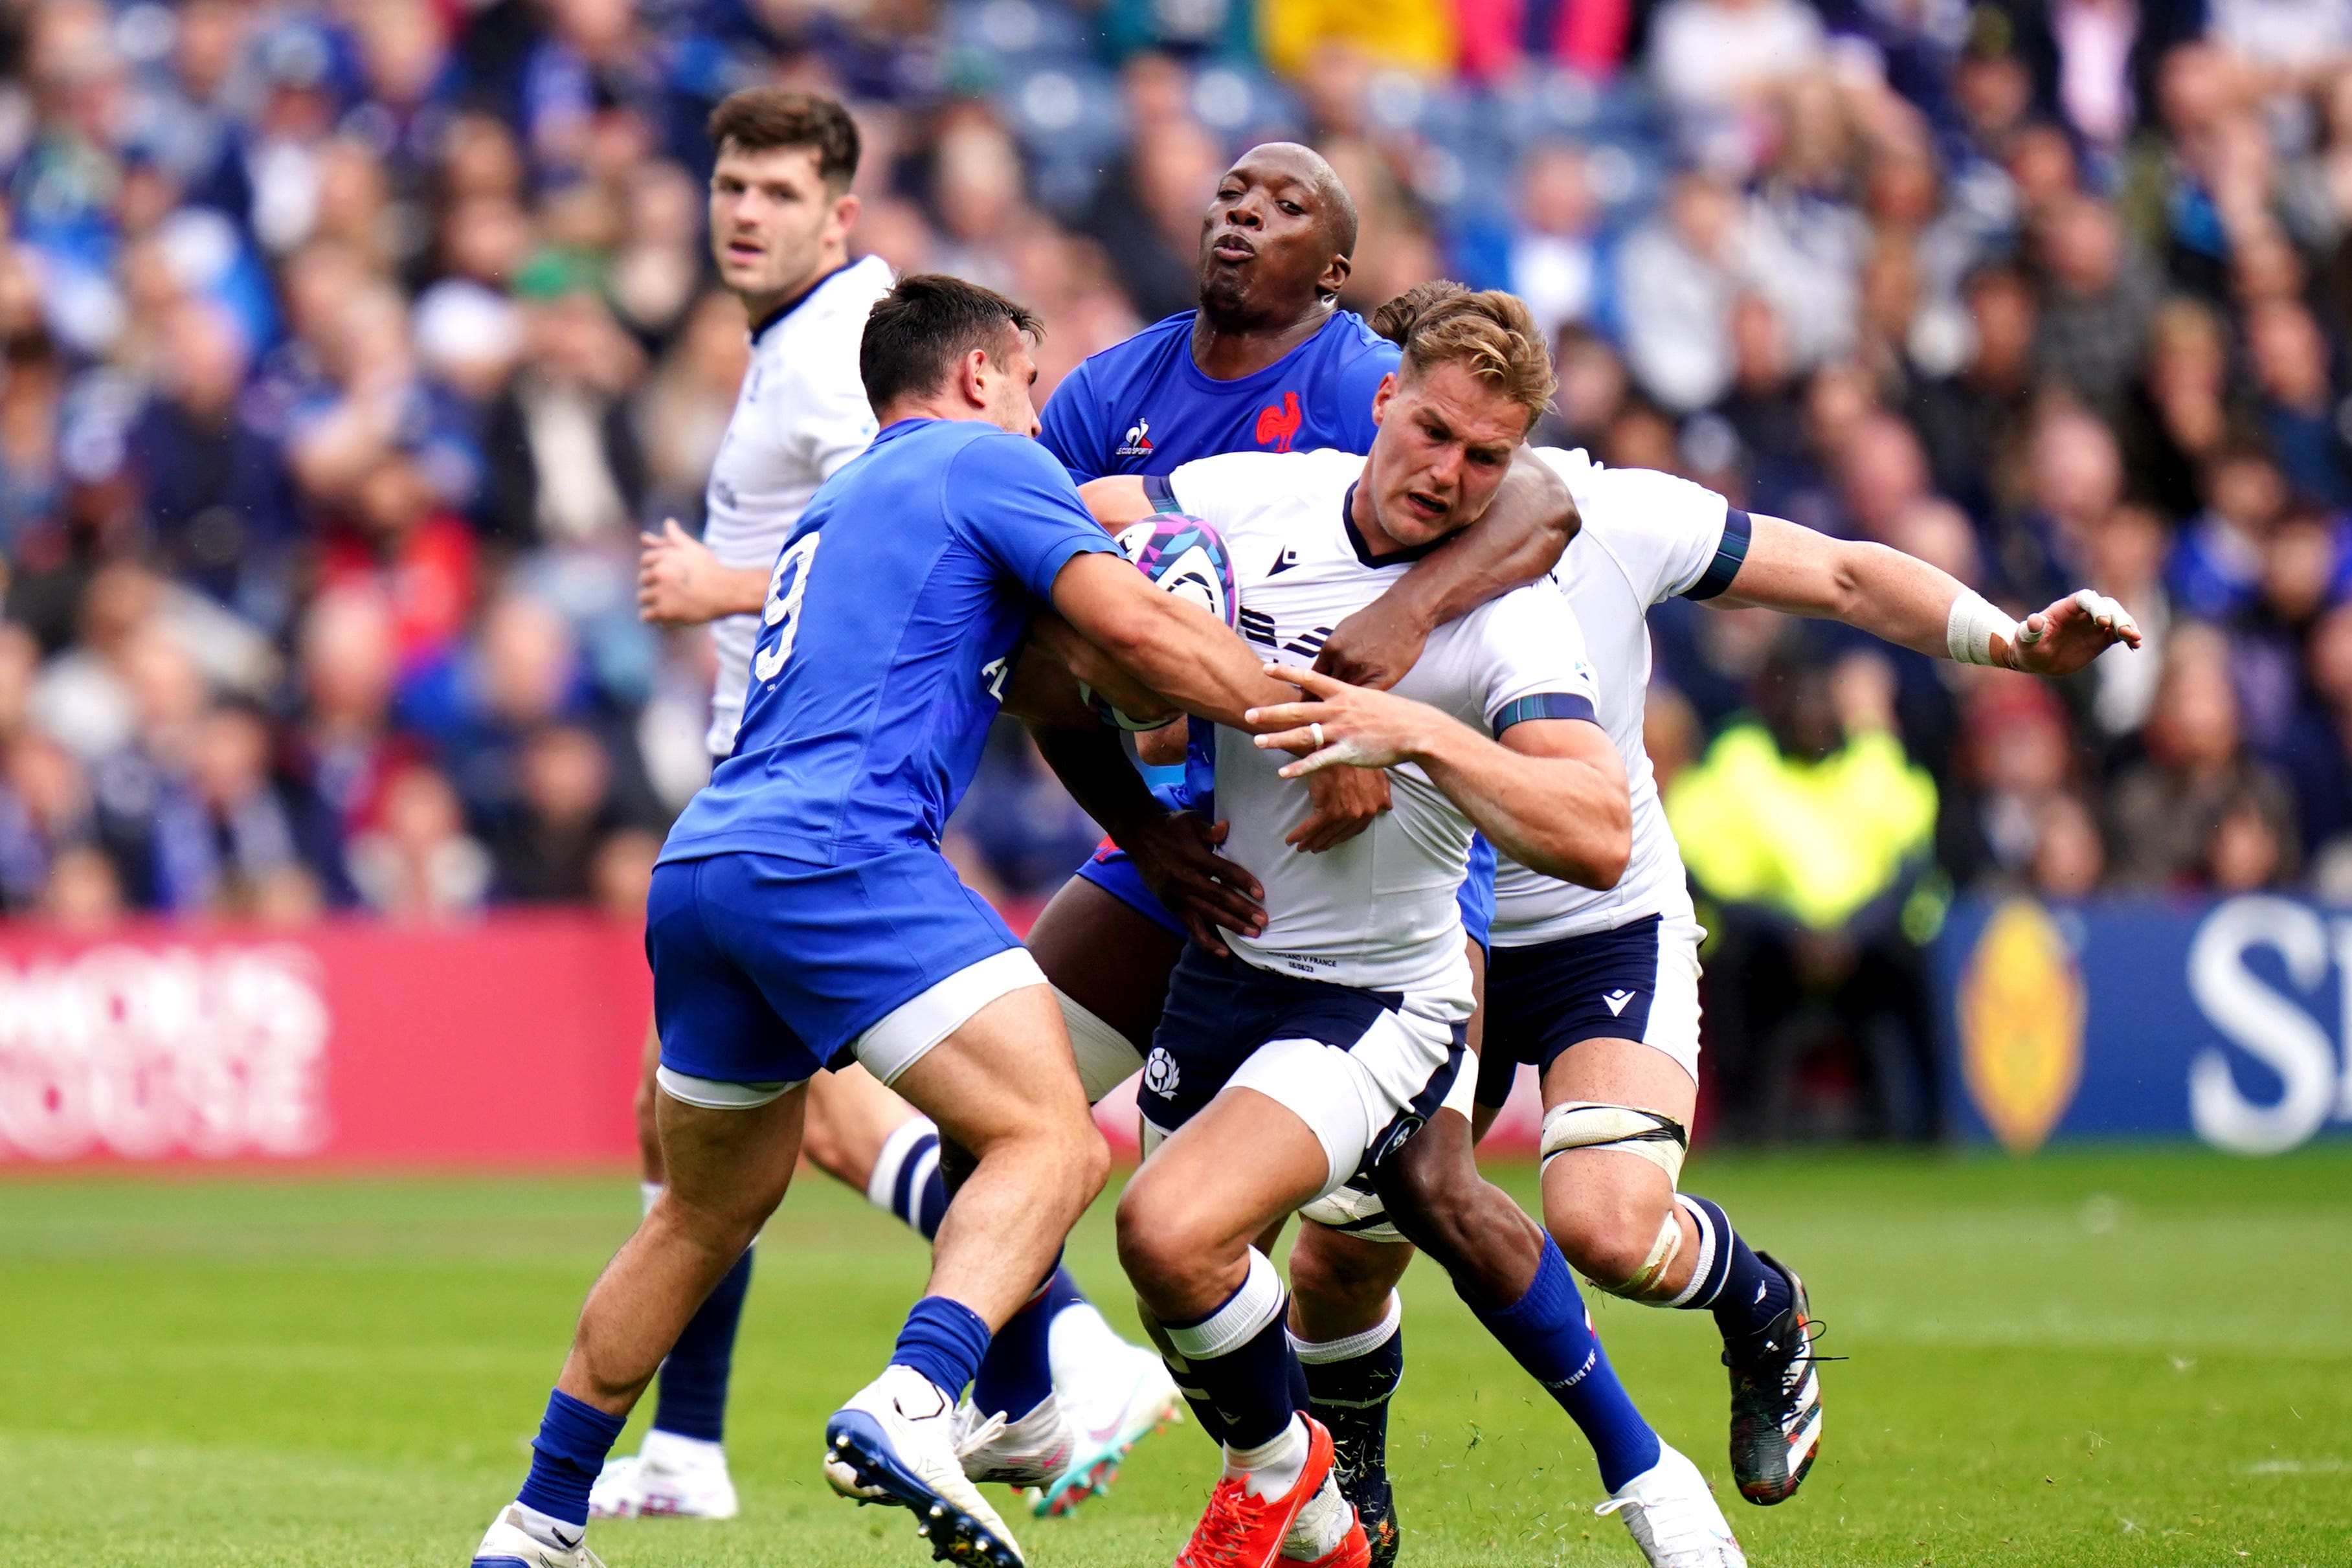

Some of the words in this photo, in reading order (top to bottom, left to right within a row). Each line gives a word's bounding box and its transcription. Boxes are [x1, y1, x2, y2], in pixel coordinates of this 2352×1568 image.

[755, 531, 820, 682] 9
[1310, 957, 1337, 967] FRANCE
[2184, 890, 2352, 1158] S
